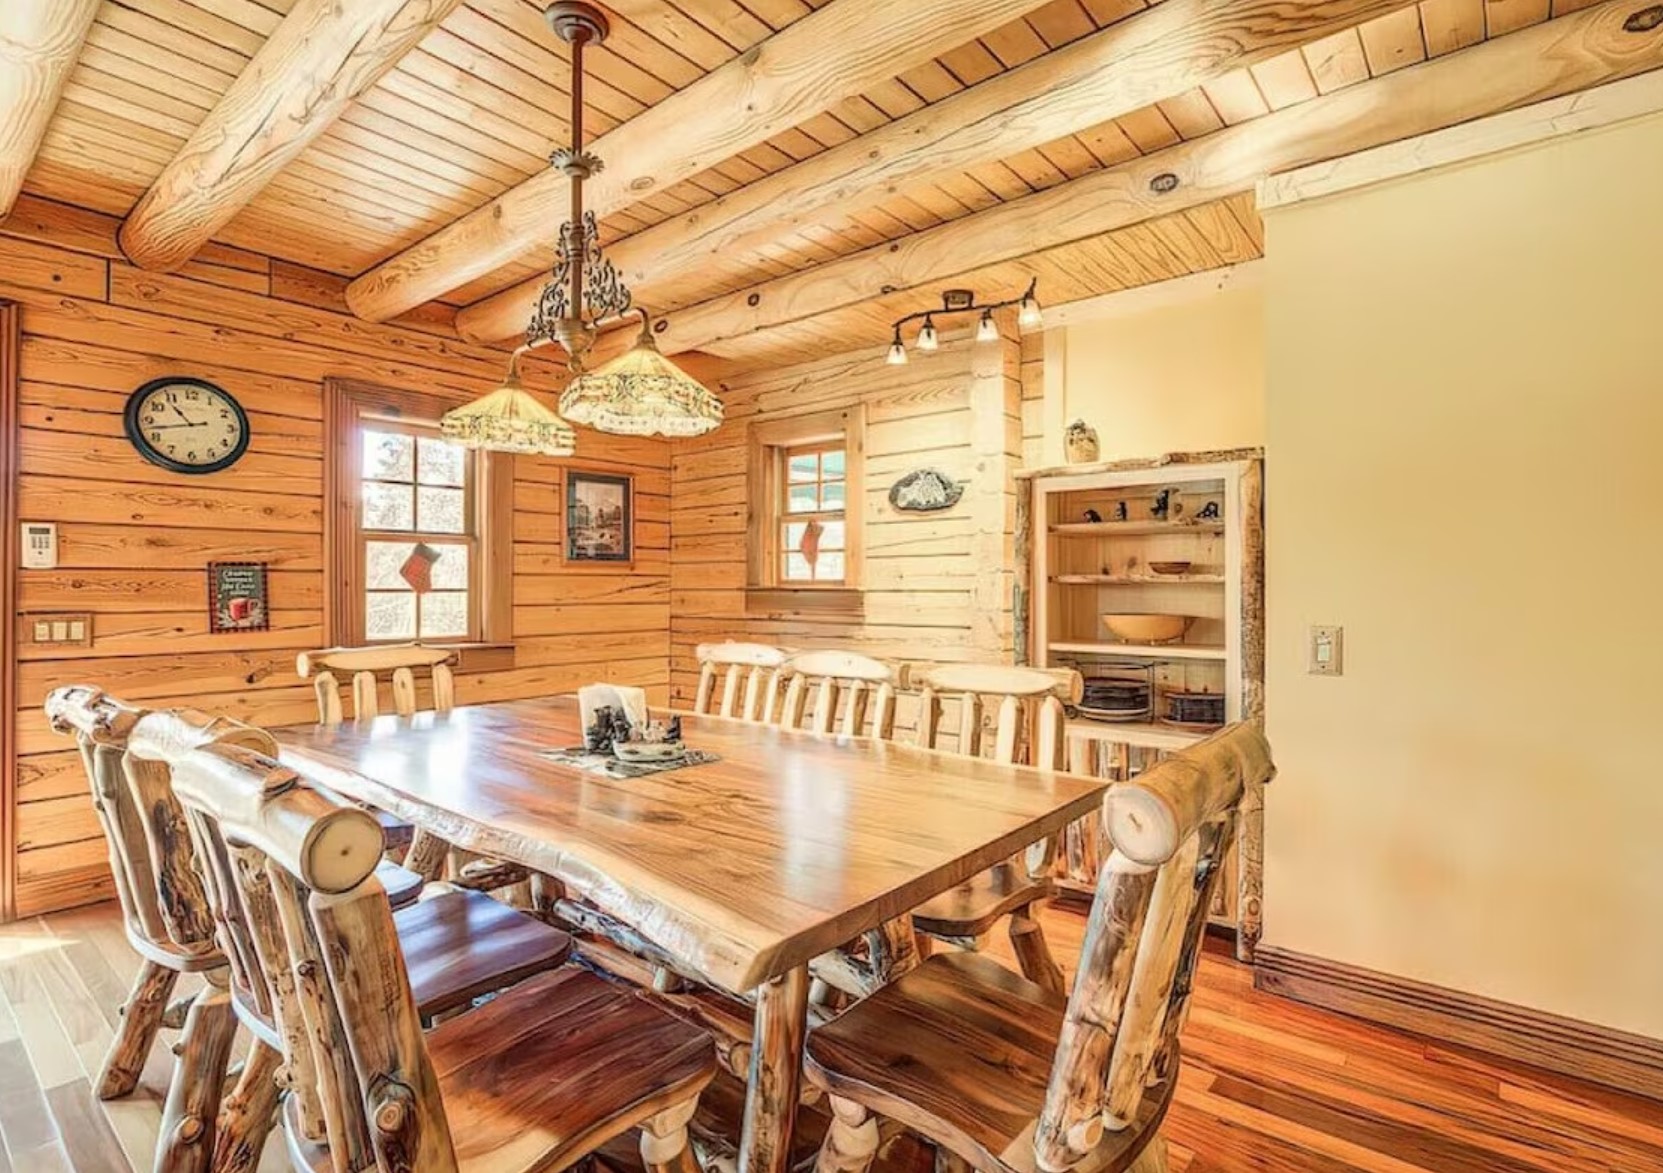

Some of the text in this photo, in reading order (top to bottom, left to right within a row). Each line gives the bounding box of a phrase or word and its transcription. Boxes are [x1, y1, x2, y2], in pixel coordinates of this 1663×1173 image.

[185, 389, 199, 401] 12
[207, 396, 212, 406] 1
[151, 401, 164, 412] 10
[220, 408, 229, 419] 2
[144, 415, 154, 425] 9
[226, 424, 235, 434] 3
[167, 444, 176, 455] 7
[187, 451, 197, 461] 6
